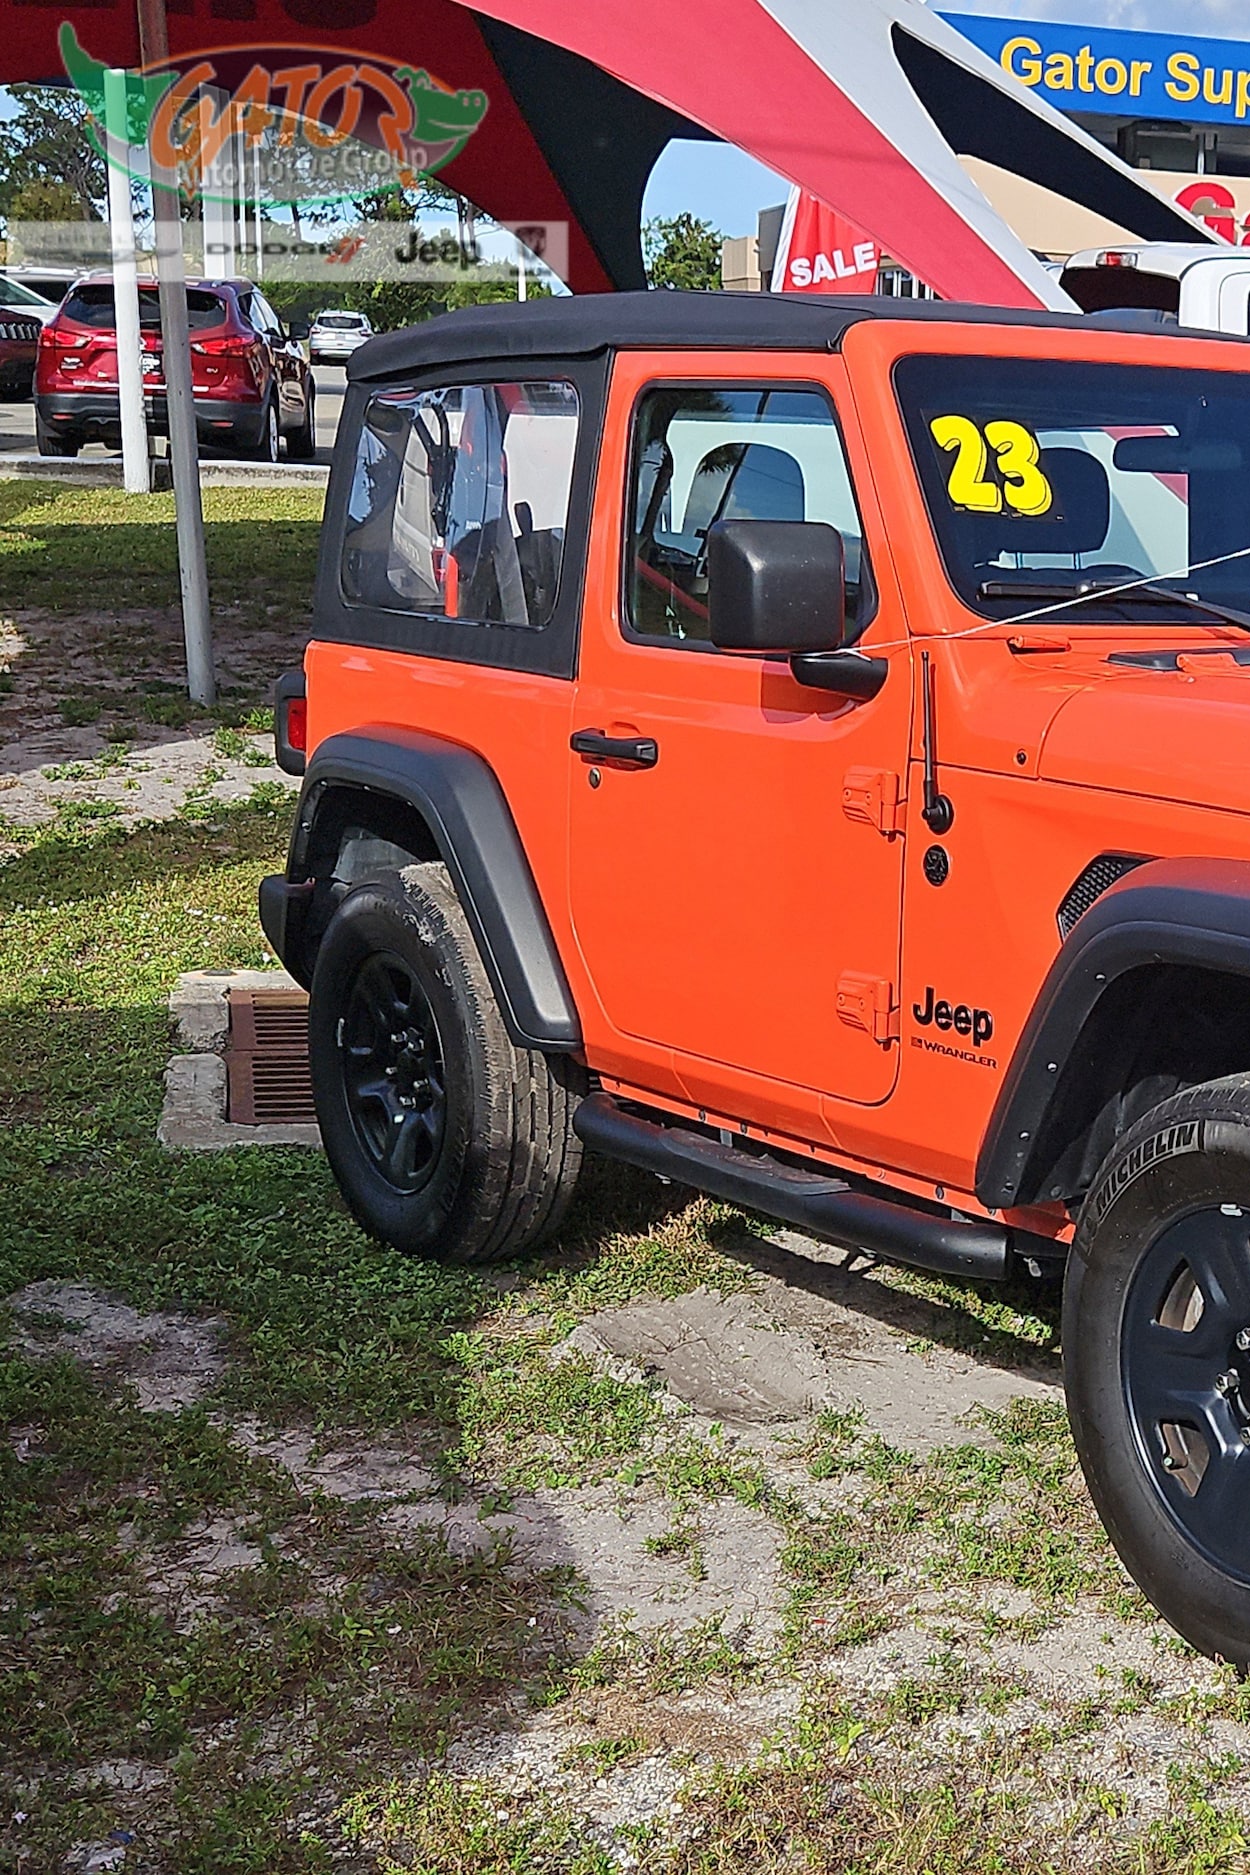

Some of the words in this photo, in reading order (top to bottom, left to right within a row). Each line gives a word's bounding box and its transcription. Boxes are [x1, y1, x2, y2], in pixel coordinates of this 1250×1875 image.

[1000, 36, 1152, 97] Gator
[789, 241, 878, 287] SALE
[930, 415, 1052, 516] 23
[913, 986, 993, 1047] Jeep
[923, 1039, 997, 1069] WRANGLER
[1096, 1123, 1197, 1218] MICHELIN
